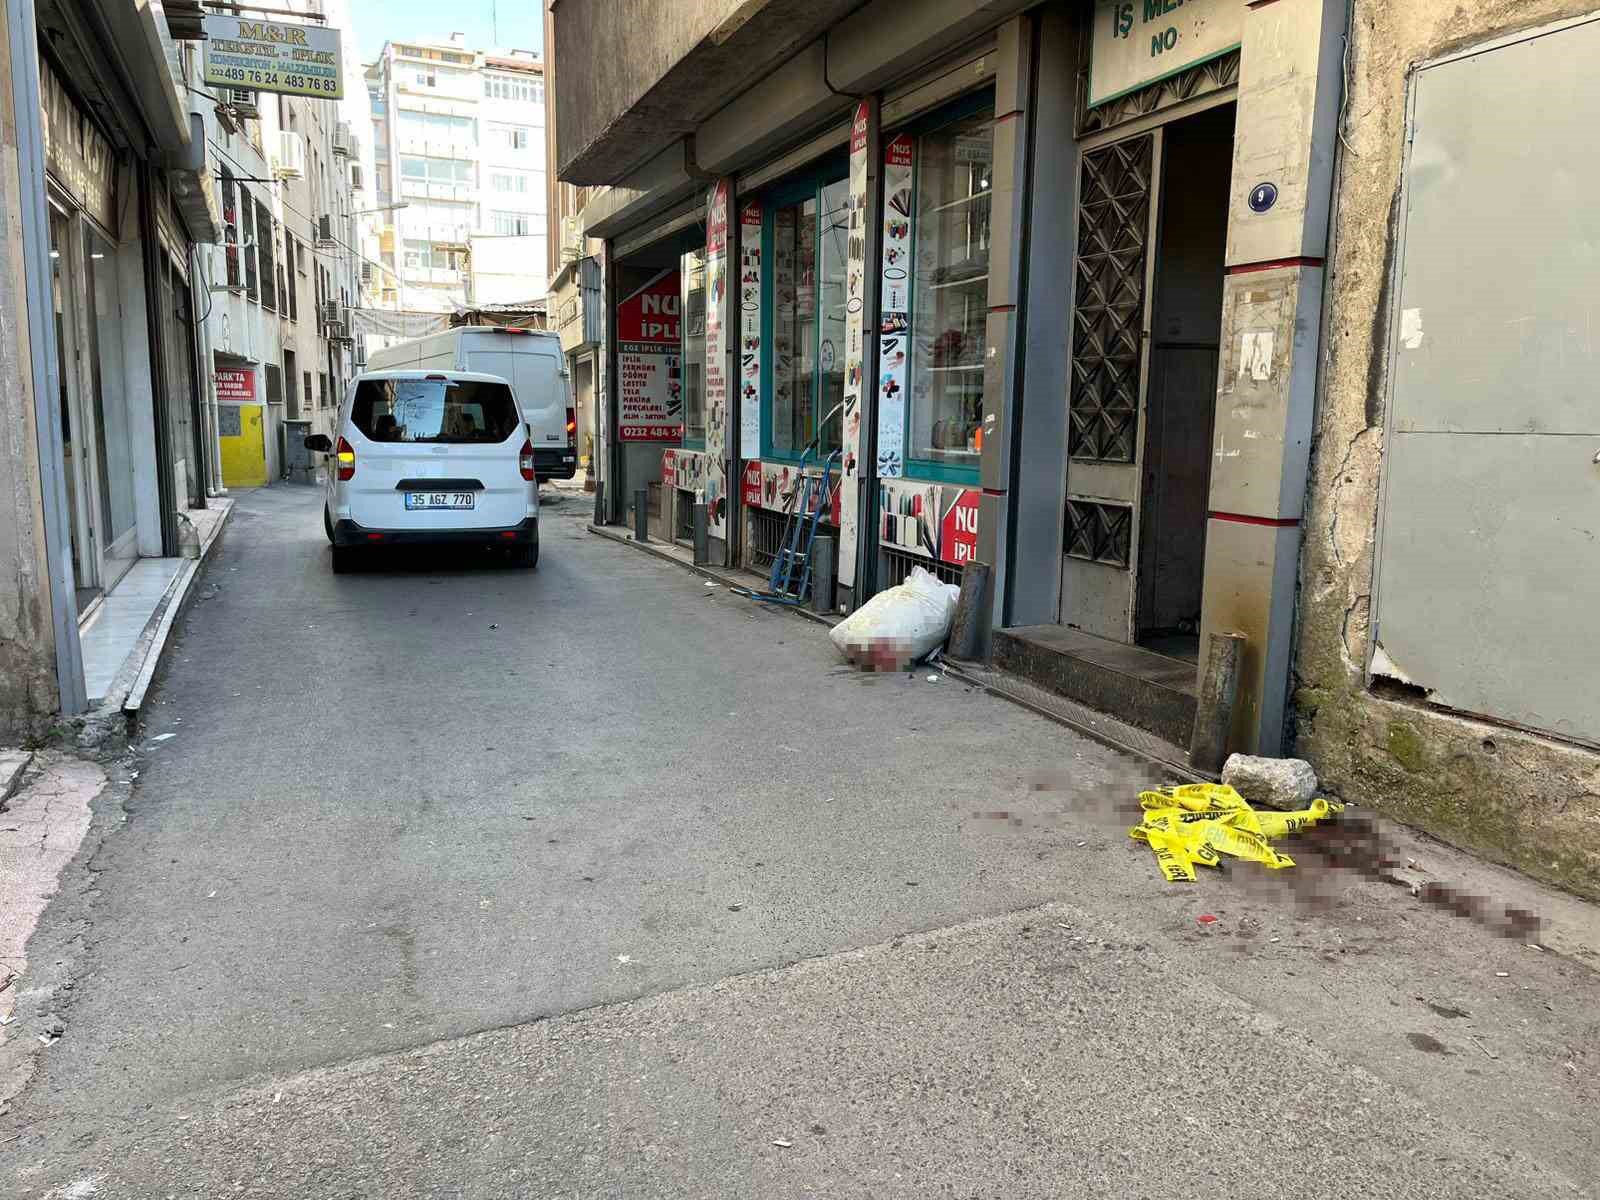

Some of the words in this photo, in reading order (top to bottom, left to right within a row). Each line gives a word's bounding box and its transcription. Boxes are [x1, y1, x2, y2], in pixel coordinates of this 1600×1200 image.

[237, 22, 309, 46] M&R
[225, 69, 245, 81] 489
[248, 70, 262, 83] 76
[265, 72, 279, 84] 24
[284, 75, 305, 88] 483
[307, 77, 320, 90] 76
[323, 79, 337, 92] 83
[641, 294, 680, 315] NU
[641, 319, 681, 338] İPLİ
[623, 427, 647, 437] 0232
[746, 469, 760, 486] NUS
[412, 494, 425, 505] 35
[429, 494, 447, 505] AGZ
[453, 494, 472, 505] 770
[955, 506, 978, 535] NU
[954, 538, 977, 561] İPLİ
